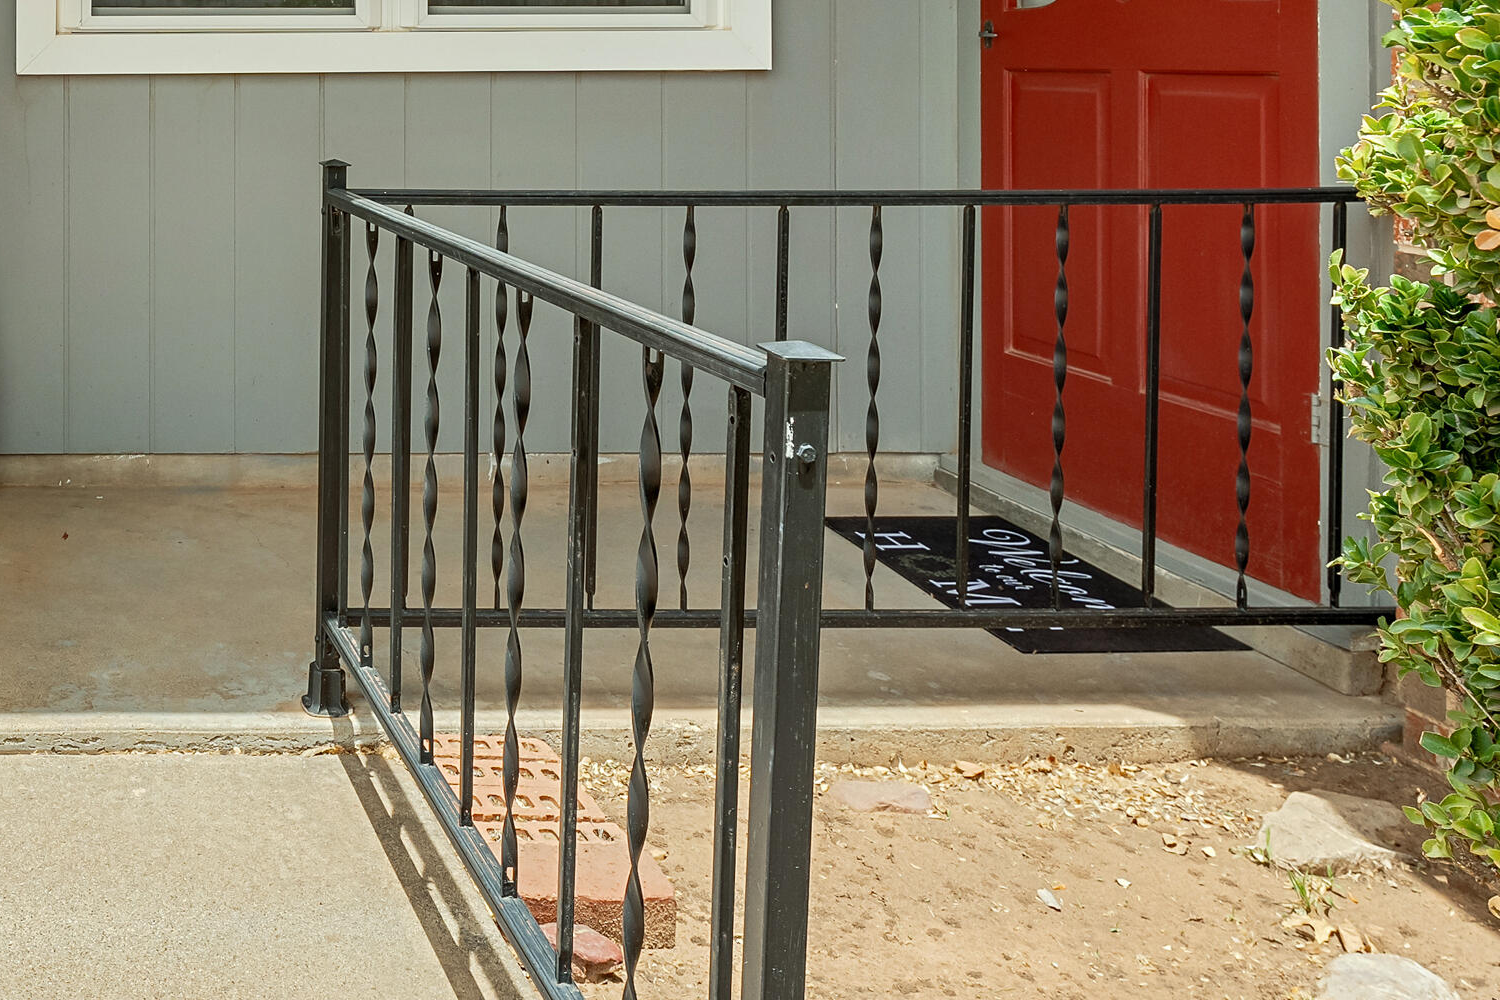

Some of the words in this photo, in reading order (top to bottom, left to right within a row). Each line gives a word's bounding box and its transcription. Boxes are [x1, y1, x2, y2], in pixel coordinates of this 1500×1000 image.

[967, 528, 1117, 610] Welcom
[978, 564, 1004, 574] to
[995, 574, 1034, 590] our
